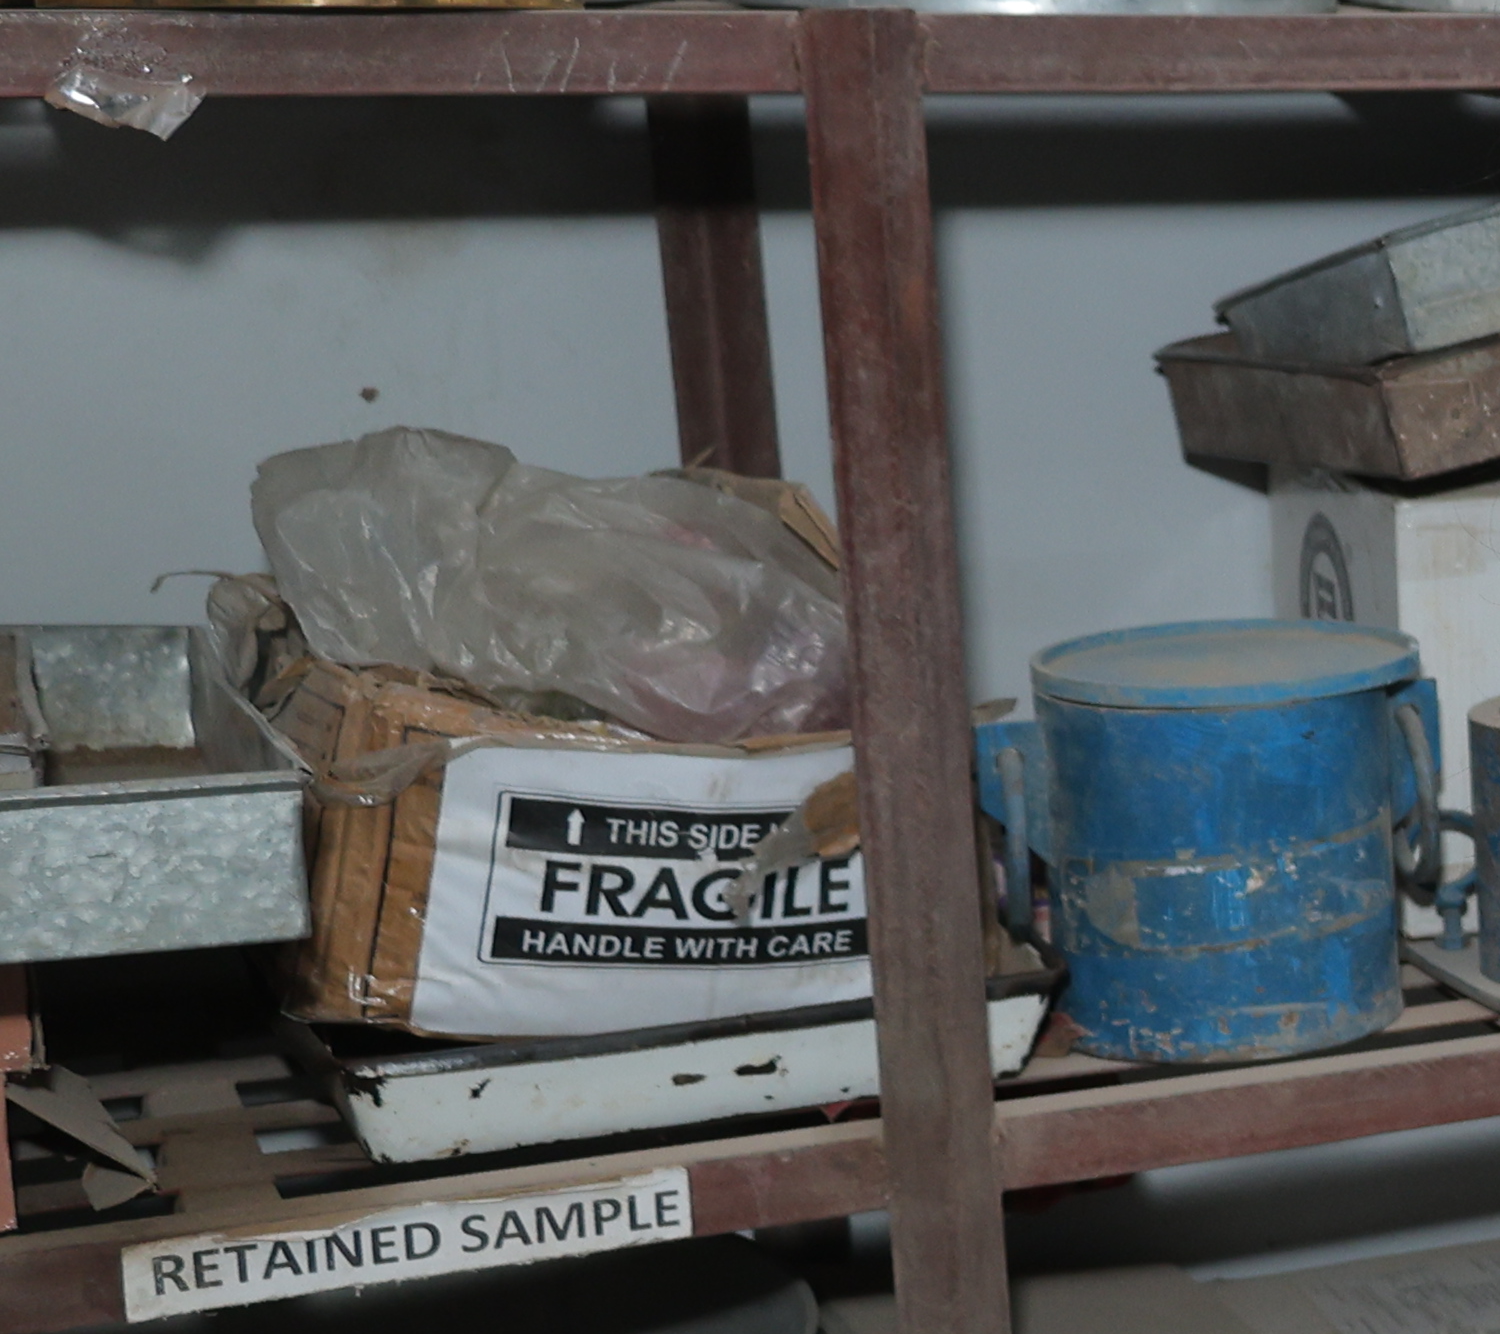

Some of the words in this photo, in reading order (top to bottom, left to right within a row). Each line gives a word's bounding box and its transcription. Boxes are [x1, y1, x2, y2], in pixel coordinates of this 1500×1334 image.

[606, 817, 680, 847] THIS
[687, 823, 762, 851] SIDE
[540, 859, 852, 922] FRAGILE
[522, 929, 665, 959] HANDLE
[675, 934, 758, 960] WITH
[766, 929, 853, 956] CARE
[152, 1221, 442, 1297] RETAINED
[460, 1190, 682, 1254] SAMPLE
